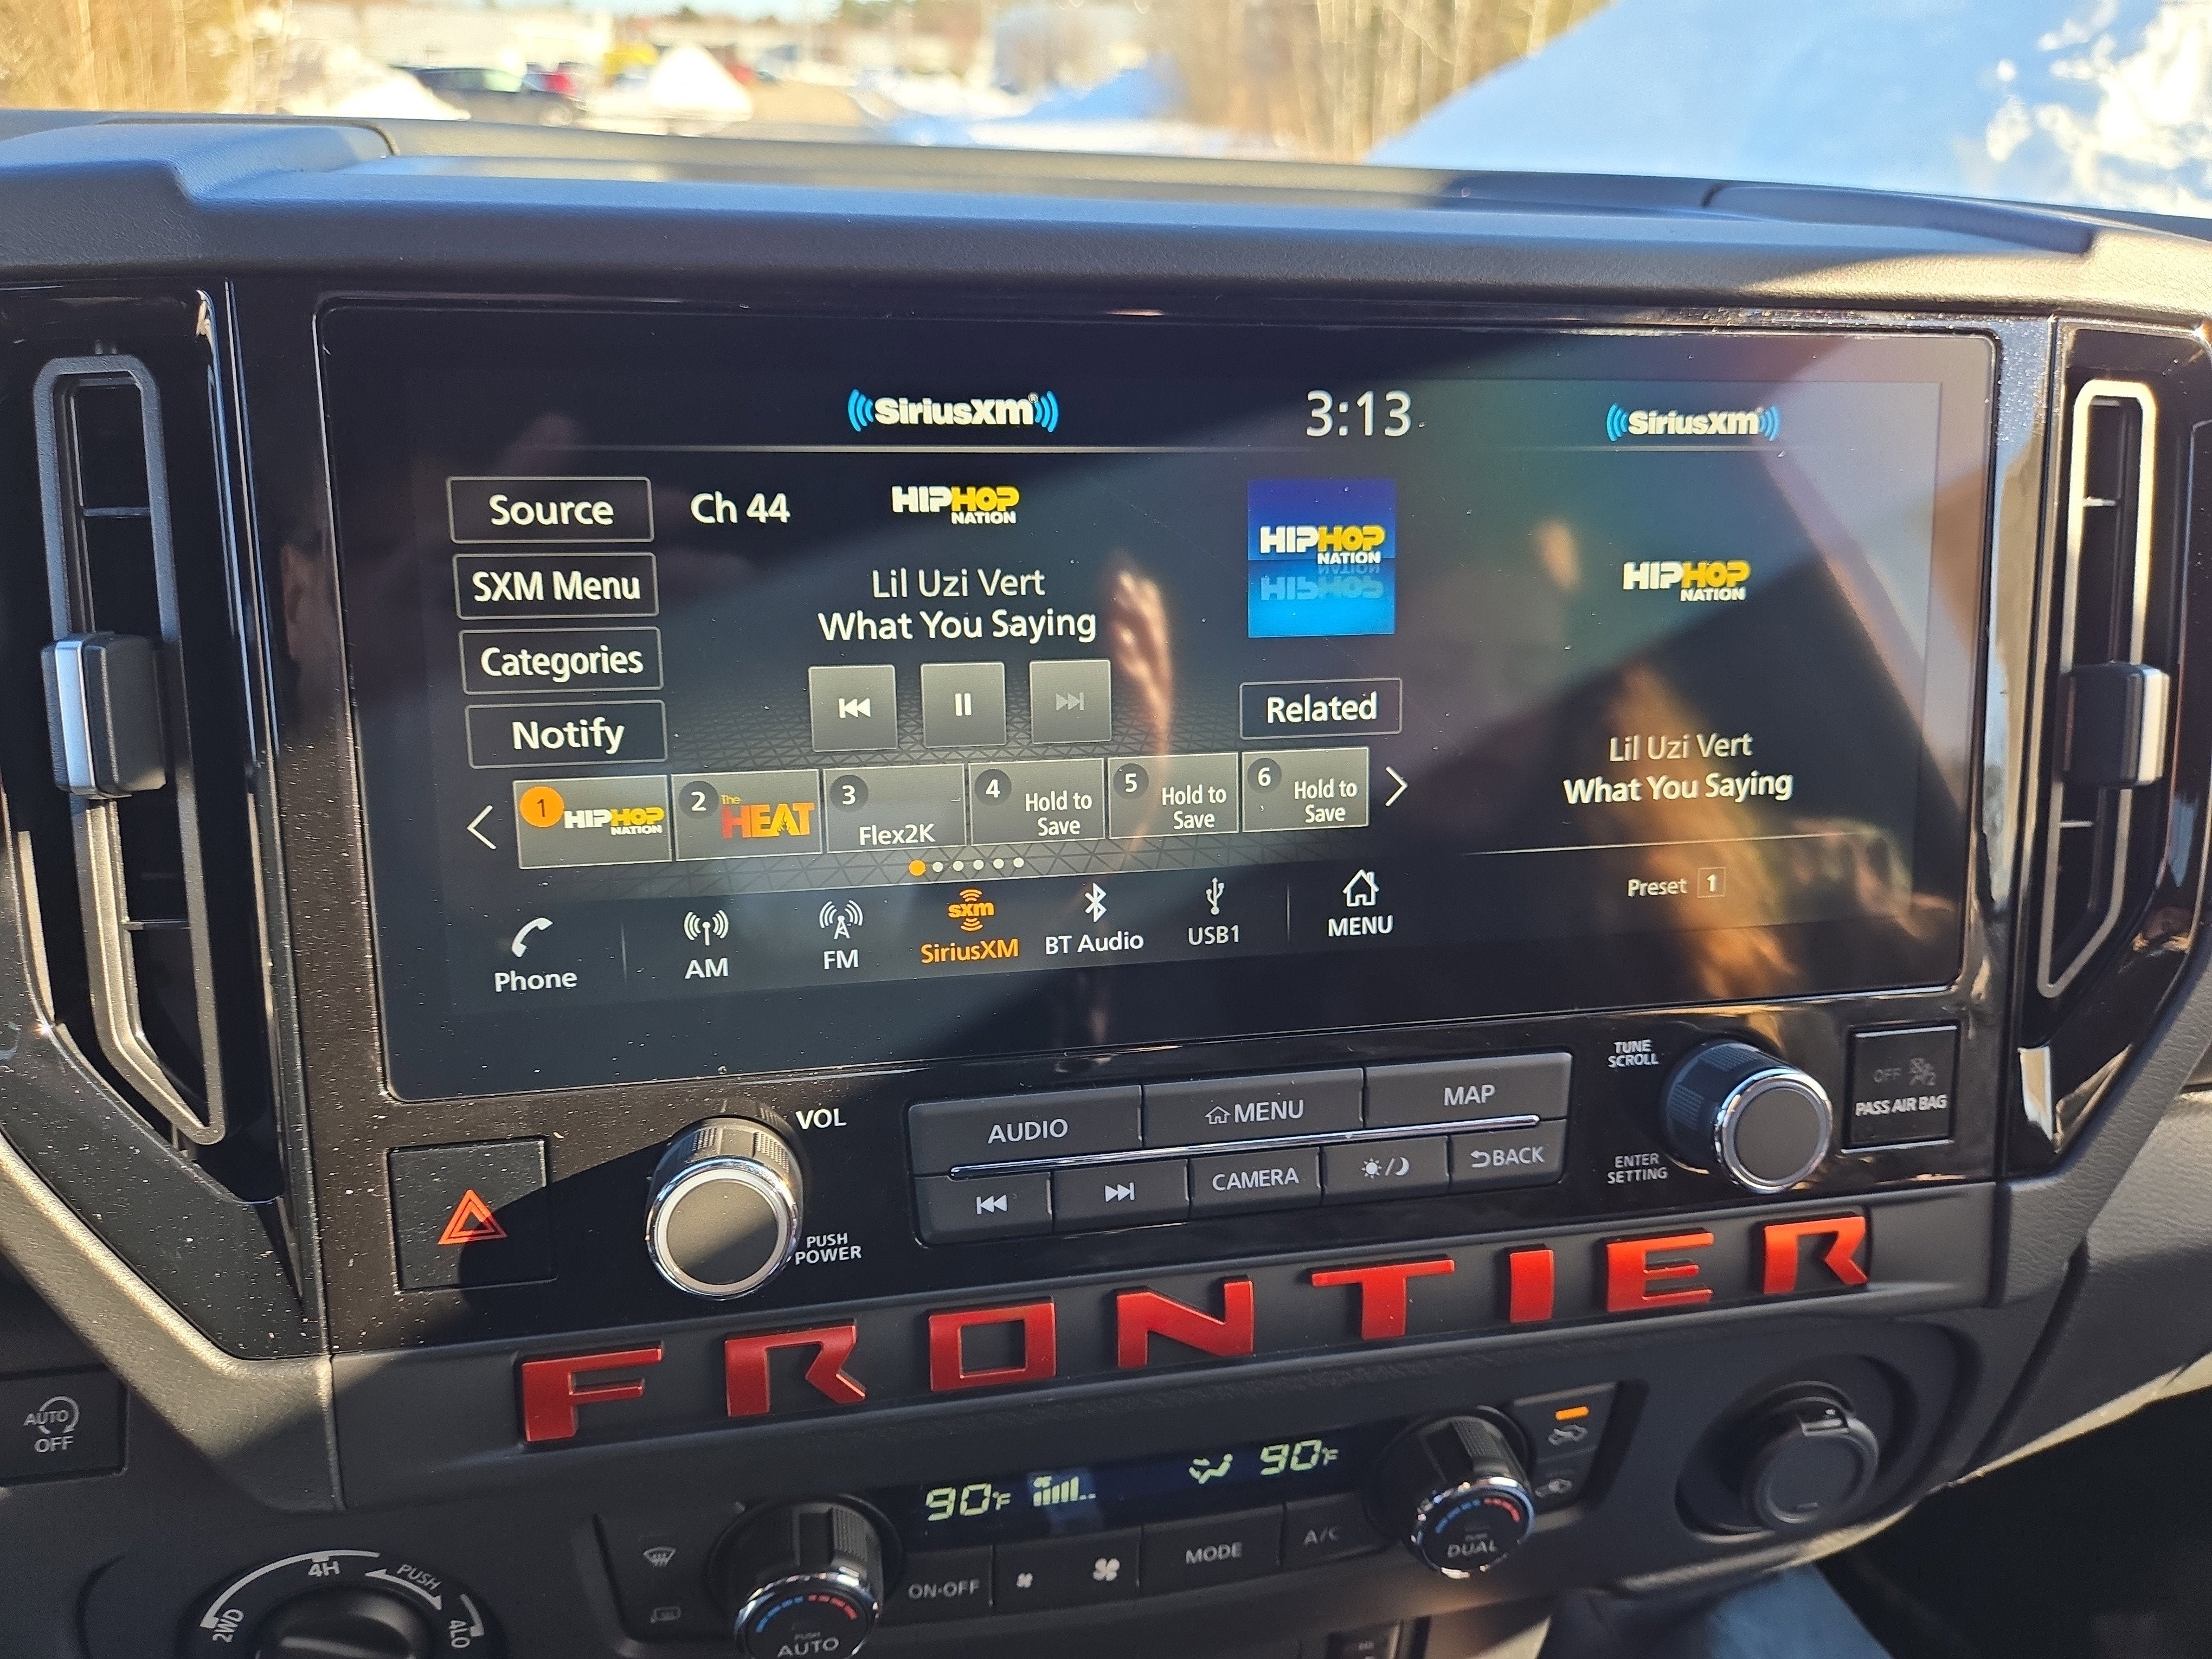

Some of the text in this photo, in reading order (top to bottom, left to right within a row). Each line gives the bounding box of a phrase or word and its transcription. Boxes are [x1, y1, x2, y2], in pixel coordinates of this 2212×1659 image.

[1306, 390, 1411, 437] 3:13
[489, 494, 614, 525] Source
[690, 491, 791, 524] Ch 44
[951, 511, 1017, 524] NATION
[1317, 551, 1381, 564] NATION
[472, 570, 641, 602] SXM Menu
[872, 568, 1045, 598] Lil Uzi Vert
[1680, 587, 1746, 602] NATION
[818, 608, 1096, 644] What You Saying
[481, 645, 644, 683] Categories
[1266, 691, 1378, 723] Related
[512, 717, 625, 755] Notify
[1609, 732, 1753, 762] Lil Uzi Vert
[1124, 773, 1138, 793] 5
[1257, 767, 1271, 787] 6
[1563, 770, 1793, 804] What You Saying
[842, 785, 856, 806] 3
[986, 779, 1001, 799] 4
[1161, 785, 1227, 806] Hold to
[1294, 779, 1357, 800] Hold to
[537, 799, 545, 818] 1
[690, 791, 707, 812] 2
[721, 795, 741, 805] The
[1025, 790, 1092, 813] Hold to
[722, 802, 815, 839] HEAT
[1173, 811, 1215, 830] Save
[1304, 804, 1346, 824] Save
[610, 825, 663, 835] NATION
[859, 823, 936, 846] Flex2K
[1037, 817, 1081, 837] Save
[1627, 873, 1717, 897] Preset 1
[1188, 924, 1240, 946] USB1
[1327, 914, 1393, 937] MENU
[921, 938, 1019, 963] SiriusXM
[1045, 930, 1144, 955] BT Audio
[685, 957, 729, 979] AM
[823, 949, 859, 970] FM
[494, 970, 578, 993] Phone
[1613, 1038, 1652, 1054] TUNE
[1607, 1052, 1660, 1069] SCROLL
[1443, 1084, 1496, 1107] MAP
[1855, 1094, 1948, 1117] PASS AIR BAG
[795, 1108, 847, 1129] VOL
[1234, 1099, 1304, 1123] MENU
[987, 1118, 1069, 1144] AUDIO
[1491, 1146, 1546, 1167] BACK
[1615, 1153, 1660, 1169] ENTER
[1212, 1167, 1300, 1192] CAMERA
[1607, 1166, 1669, 1185] SETTING
[806, 1232, 848, 1248] PUSH
[795, 1245, 862, 1265] POWER
[522, 1216, 1868, 1443] FRONTIER
[23, 1410, 69, 1426] AUTO
[34, 1436, 74, 1453] OFF
[1304, 1526, 1340, 1546] A/C
[1185, 1542, 1243, 1565] MODE
[1448, 1540, 1497, 1558] DUAL
[308, 1561, 340, 1577] 4H
[397, 1564, 442, 1590] PUSH
[213, 1608, 244, 1643] 2WD
[449, 1620, 471, 1648] 4LO
[777, 1637, 840, 1658] AUTO
